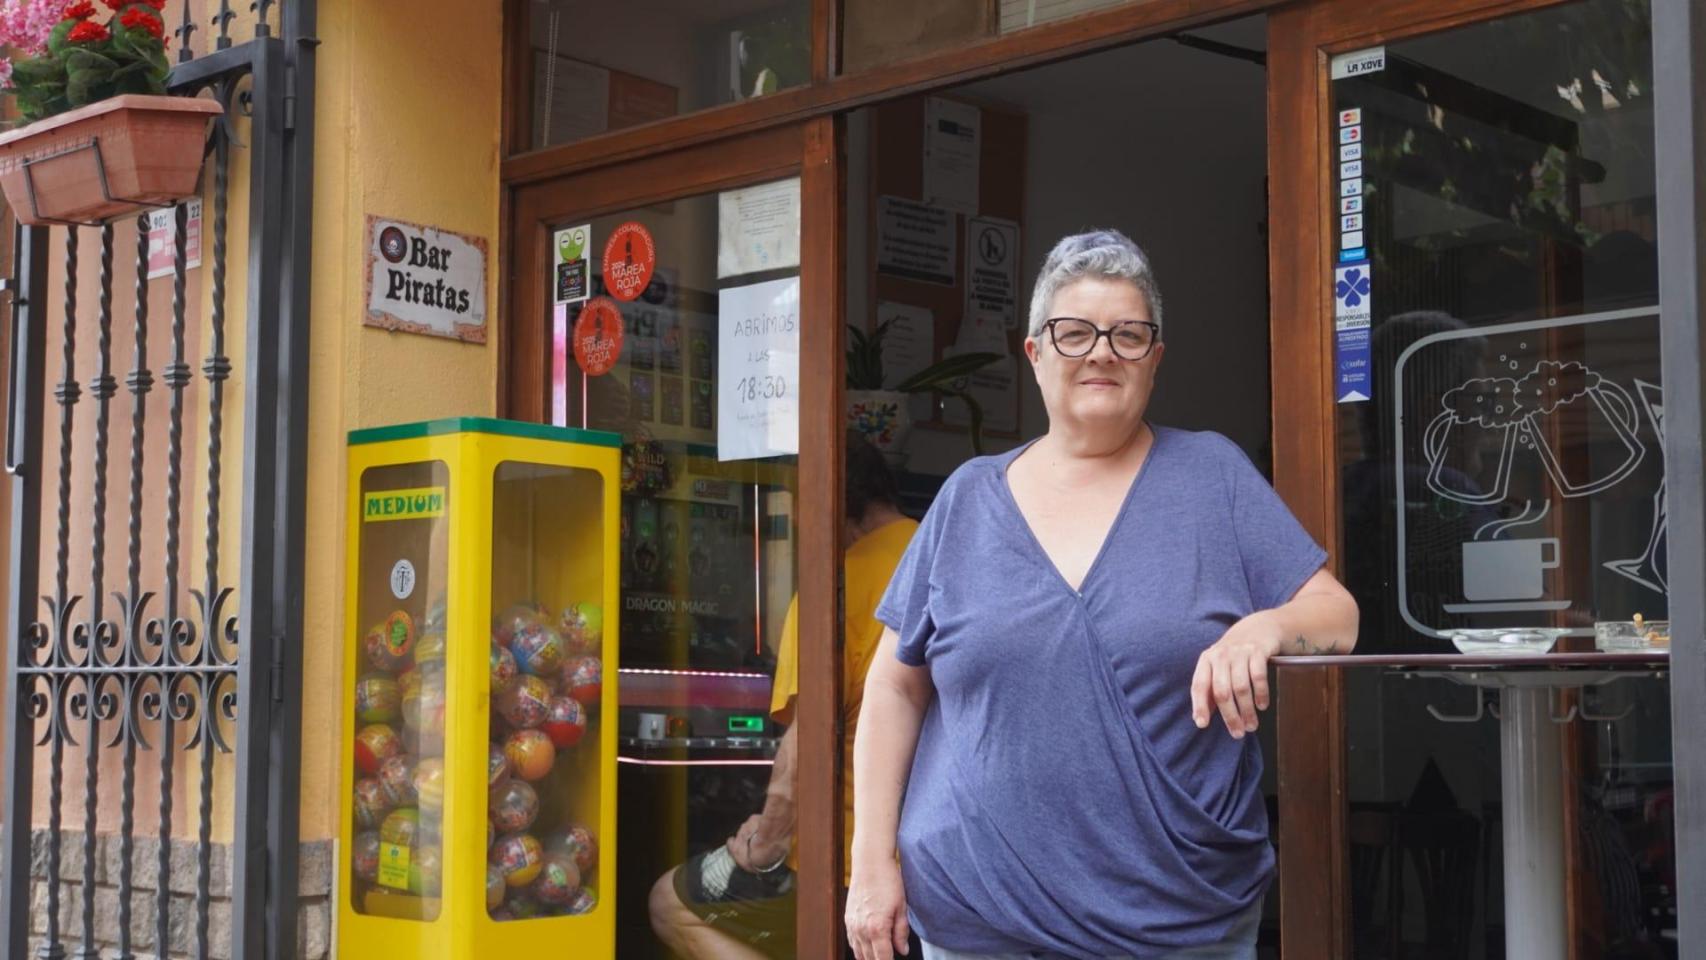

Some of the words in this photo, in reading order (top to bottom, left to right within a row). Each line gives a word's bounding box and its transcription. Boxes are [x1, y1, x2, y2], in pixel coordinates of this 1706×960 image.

[1347, 63, 1358, 73] LA
[408, 236, 452, 272] Bar
[612, 262, 645, 280] MAREA
[385, 268, 470, 314] Piratas
[616, 275, 642, 290] ROJA
[582, 337, 615, 354] MAREA
[587, 350, 611, 365] ROJA
[736, 376, 786, 403] 18:30
[366, 494, 441, 516] MEDIUM
[625, 597, 676, 614] DRAGON
[680, 599, 720, 616] MAGIC
